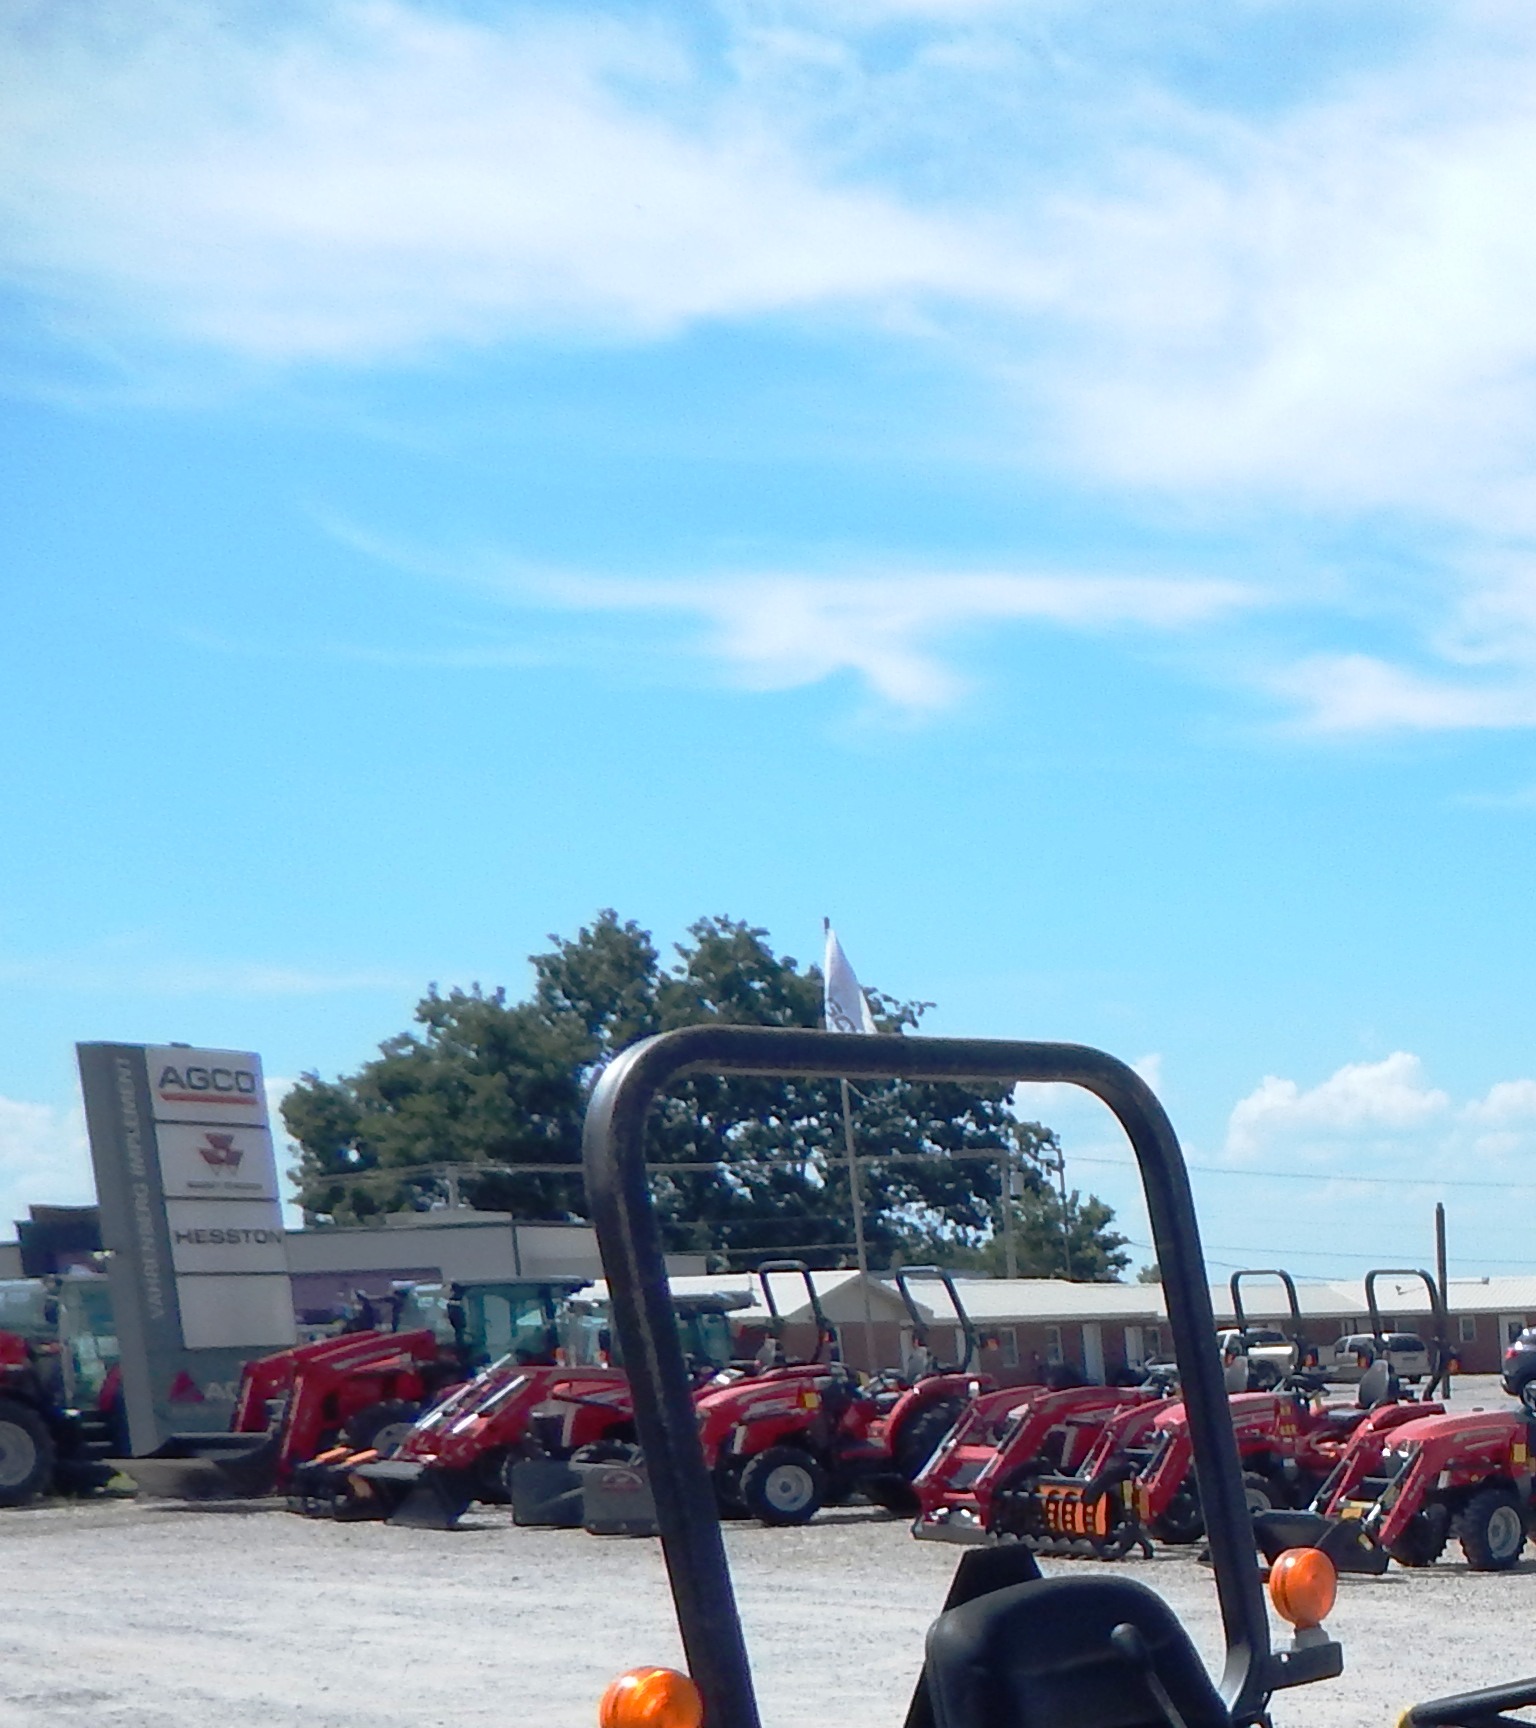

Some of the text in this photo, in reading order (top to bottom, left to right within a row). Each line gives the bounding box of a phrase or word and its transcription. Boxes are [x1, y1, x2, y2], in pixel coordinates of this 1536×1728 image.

[158, 1066, 257, 1093] AGCO
[115, 1057, 146, 1177] IMPLEMENT
[175, 1229, 283, 1244] HESSTON
